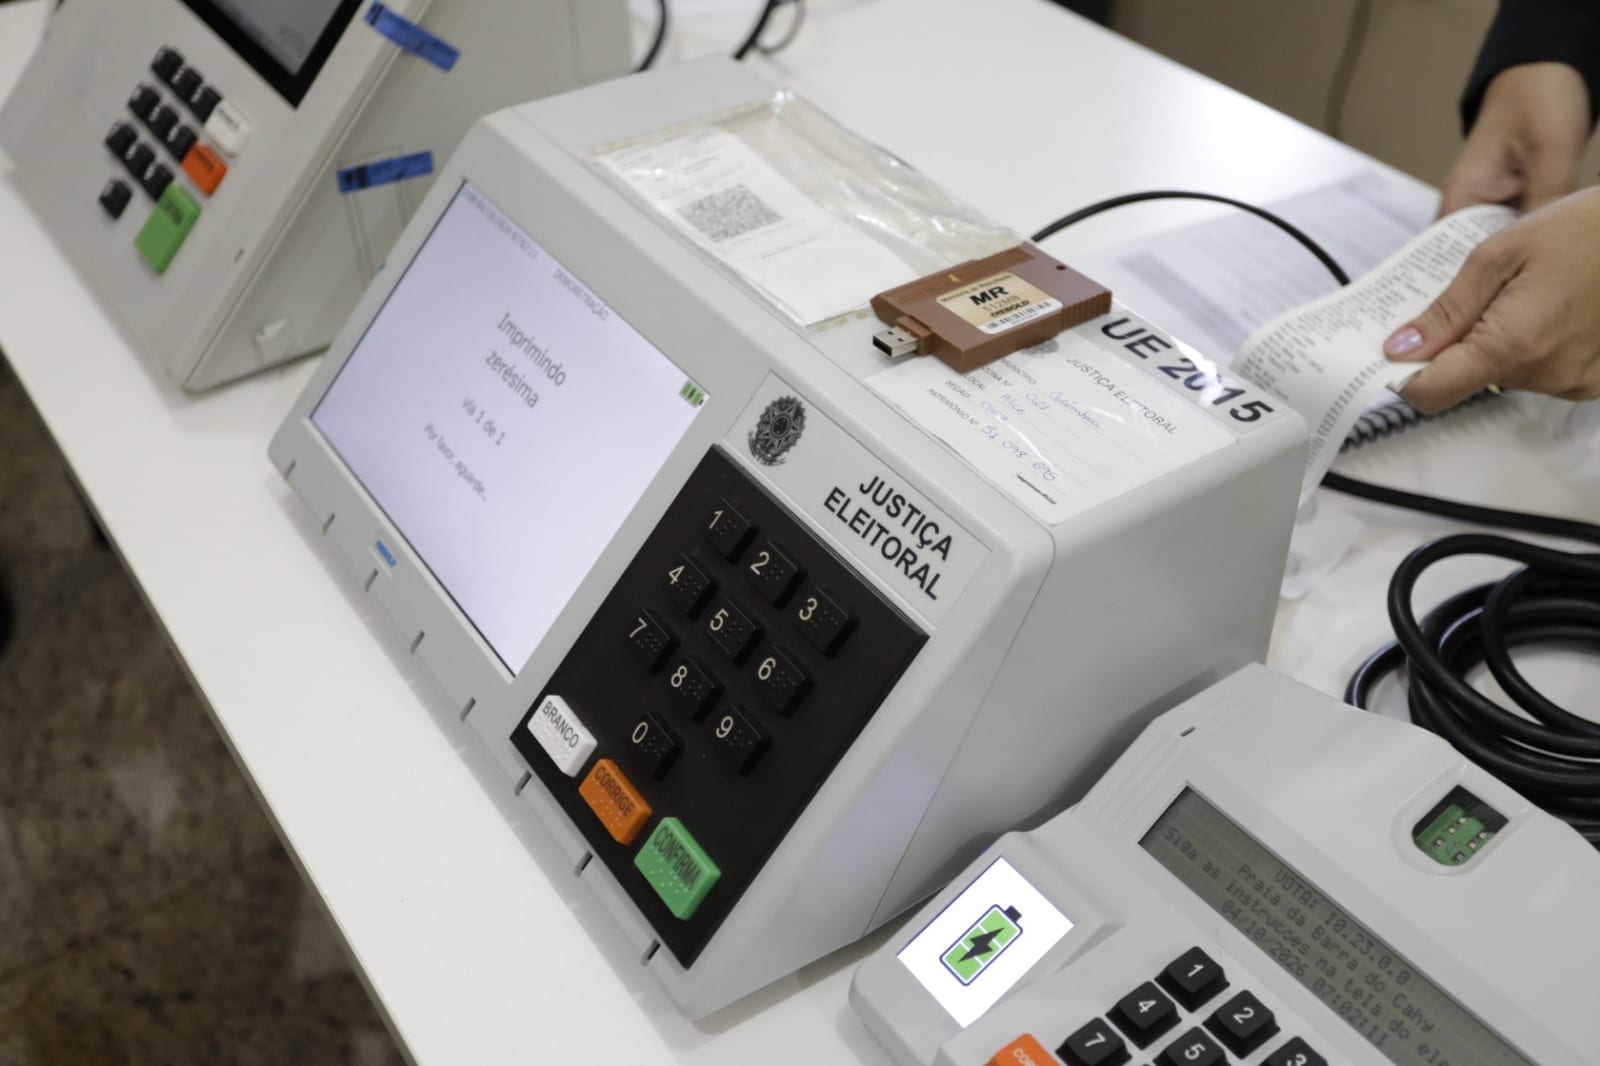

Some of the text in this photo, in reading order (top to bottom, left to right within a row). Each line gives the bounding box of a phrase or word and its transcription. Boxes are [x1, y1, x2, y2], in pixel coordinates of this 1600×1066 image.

[969, 286, 1009, 306] MR
[982, 295, 1021, 312] 512MB
[497, 312, 566, 386] Imprimindo
[1101, 317, 1172, 359] UE
[485, 350, 540, 408] zerésima
[1066, 357, 1178, 435] JUSTIÇA ELEITORAL
[424, 421, 438, 440] Por
[462, 397, 506, 446] via 1 de 1
[709, 509, 724, 530] 1
[859, 476, 953, 561] JUSTIÇA
[823, 486, 941, 601] ELEITORAL
[668, 565, 686, 585] 4
[750, 551, 770, 575] 2
[709, 608, 729, 631] 5
[799, 597, 818, 621] 3
[629, 617, 648, 638] 7
[670, 665, 688, 688] 8
[758, 657, 777, 680] 6
[541, 700, 580, 749] BRANCO
[631, 721, 649, 744] 0
[715, 715, 734, 739] 9
[594, 766, 635, 817] CORRIGE
[653, 826, 702, 890] CONFIRMA
[1163, 827, 1198, 860] Siga
[1202, 862, 1220, 879] as
[1225, 879, 1310, 955] instrucoes
[1315, 957, 1337, 979] na
[1343, 977, 1383, 1017] tela
[1388, 1019, 1411, 1041] do
[1236, 863, 1435, 1034] Praia da Barra do Cahy
[1324, 912, 1411, 986] 10.23.0.0
[1187, 963, 1204, 978] 1
[1221, 900, 1389, 1046] 04/10/2026 07:02:11
[1137, 999, 1157, 1014] 4
[1233, 1007, 1255, 1025] 2
[1084, 1032, 1106, 1049] 7
[1184, 1043, 1206, 1060] 5
[1286, 1053, 1307, 1066] 3
